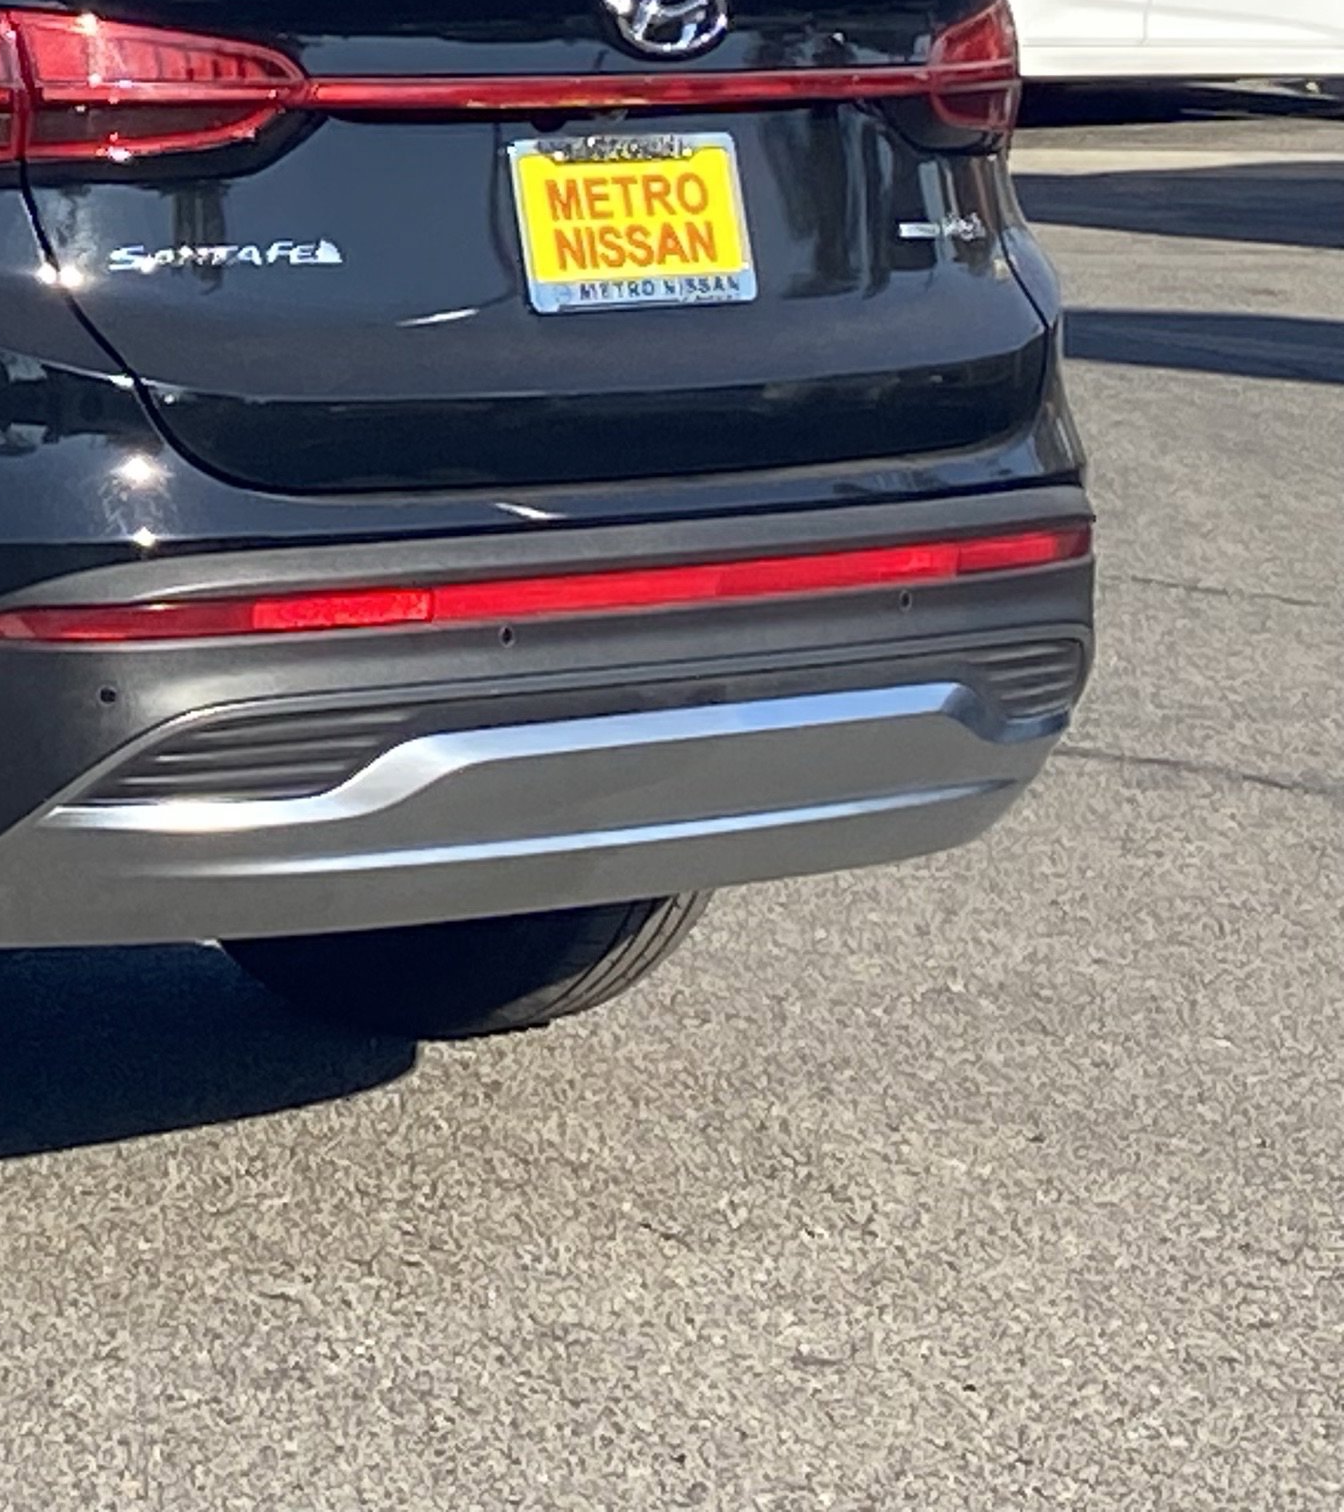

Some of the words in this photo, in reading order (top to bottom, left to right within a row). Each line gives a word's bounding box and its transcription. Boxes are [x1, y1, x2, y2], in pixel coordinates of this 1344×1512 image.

[544, 172, 710, 222] METRO
[554, 221, 719, 272] NISSAN
[579, 279, 656, 301] METRO
[662, 274, 741, 298] NISSAN
